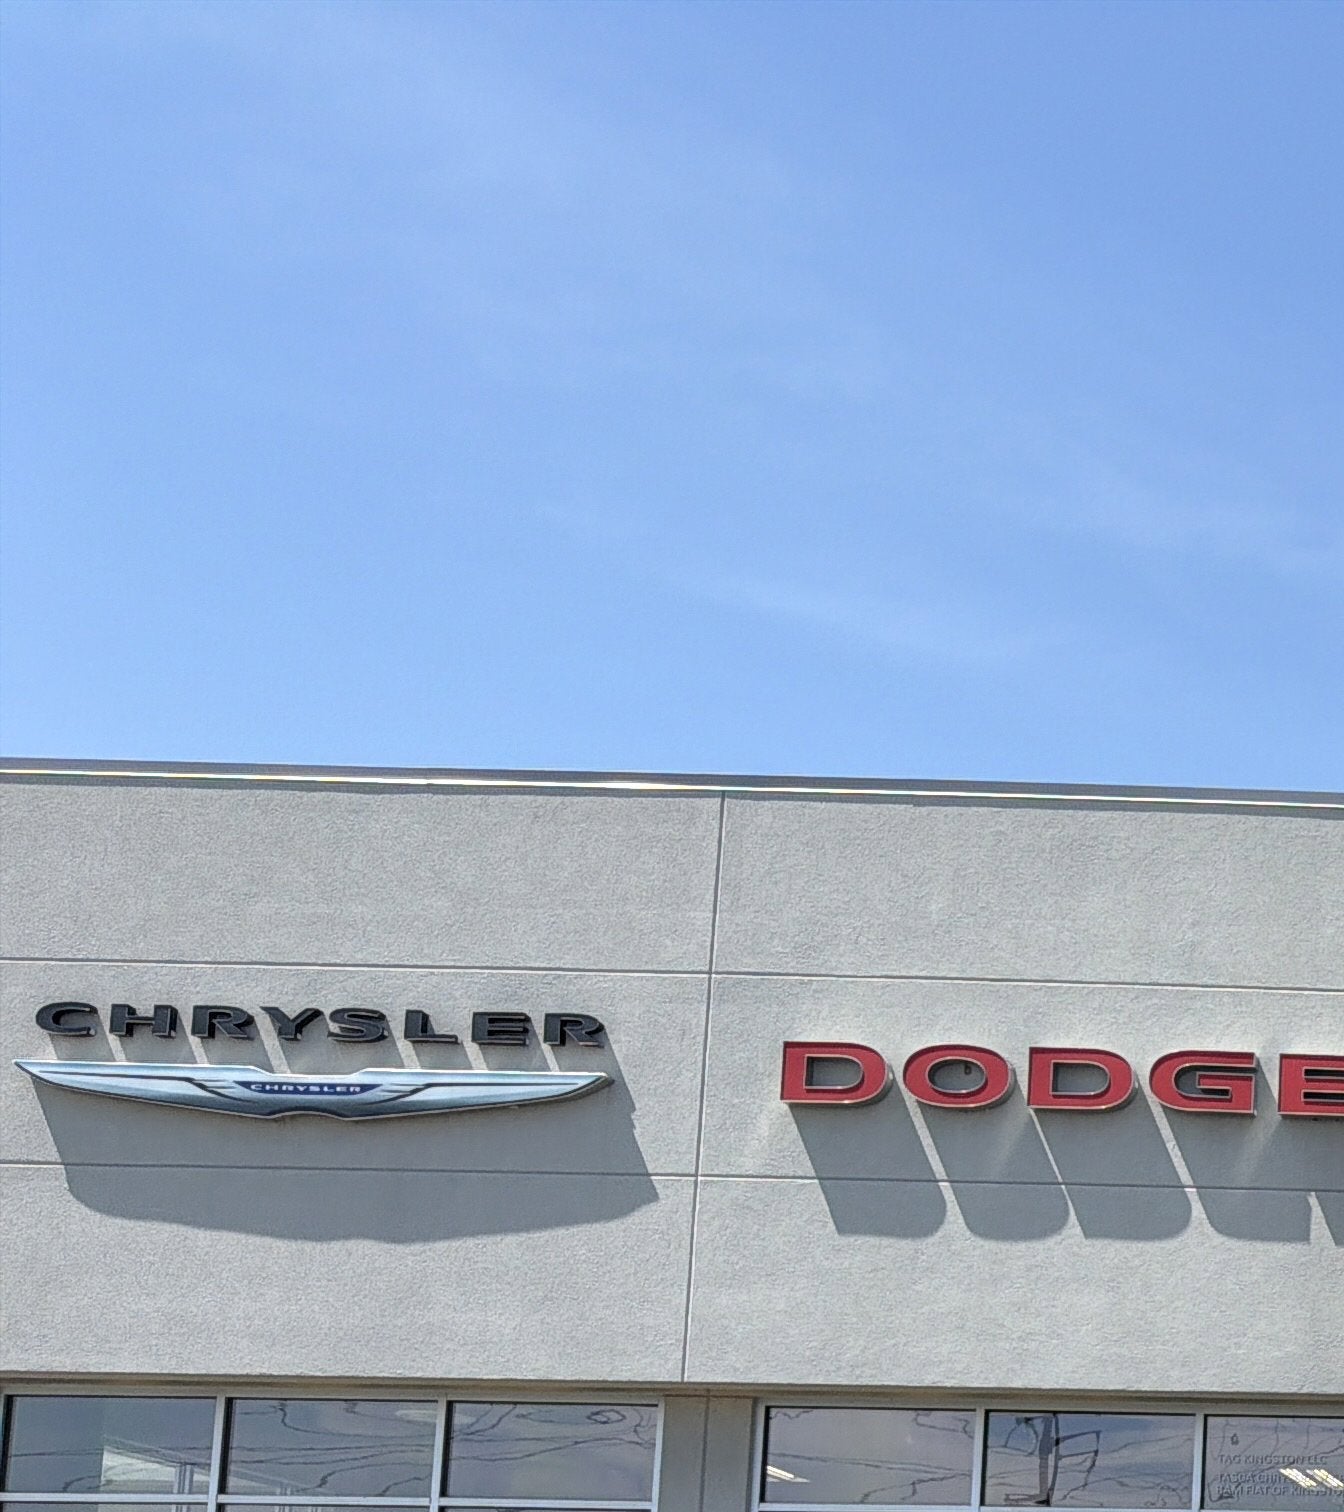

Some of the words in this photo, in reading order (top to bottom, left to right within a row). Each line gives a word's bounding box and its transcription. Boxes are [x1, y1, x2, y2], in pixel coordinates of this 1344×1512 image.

[35, 1001, 607, 1048] CHRYSLER
[250, 1083, 361, 1093] CHRYSLER
[1244, 1454, 1305, 1465] KINGSTON
